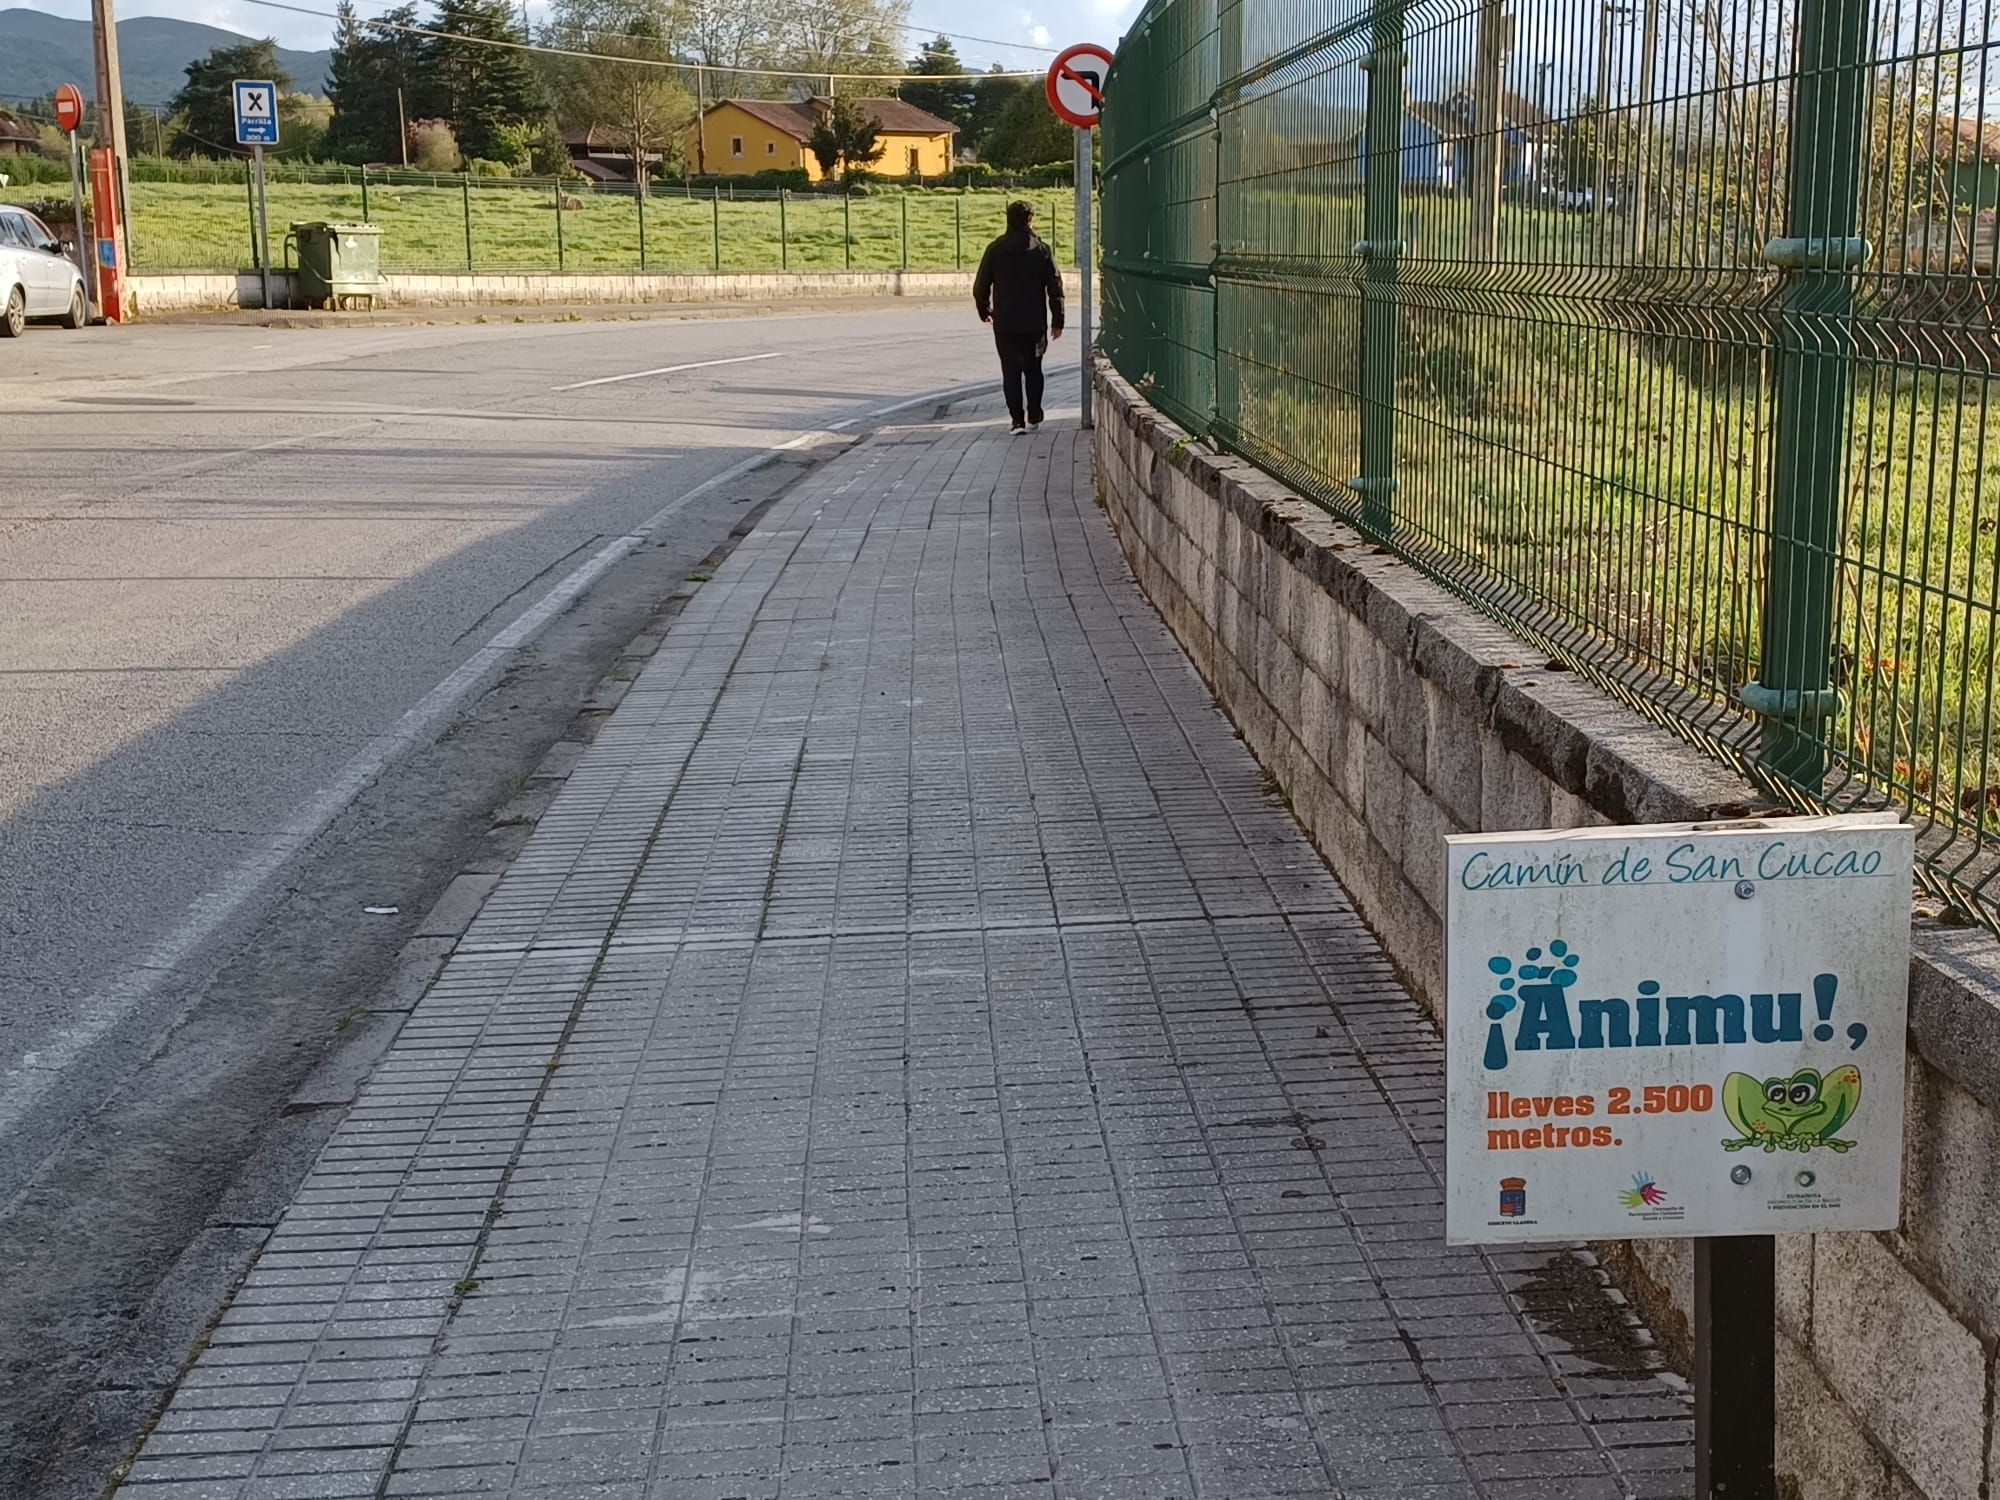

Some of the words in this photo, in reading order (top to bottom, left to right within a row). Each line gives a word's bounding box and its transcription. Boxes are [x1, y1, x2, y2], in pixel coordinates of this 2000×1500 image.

[241, 117, 272, 125] Parrilla
[1461, 851, 1588, 890] Camín
[1602, 846, 1652, 885] de
[1666, 843, 1744, 883] San
[1758, 841, 1881, 880] Cucao
[1487, 1091, 1595, 1119] lleves
[1607, 1084, 1713, 1115] 2.500
[1487, 1122, 1623, 1150] metros.
